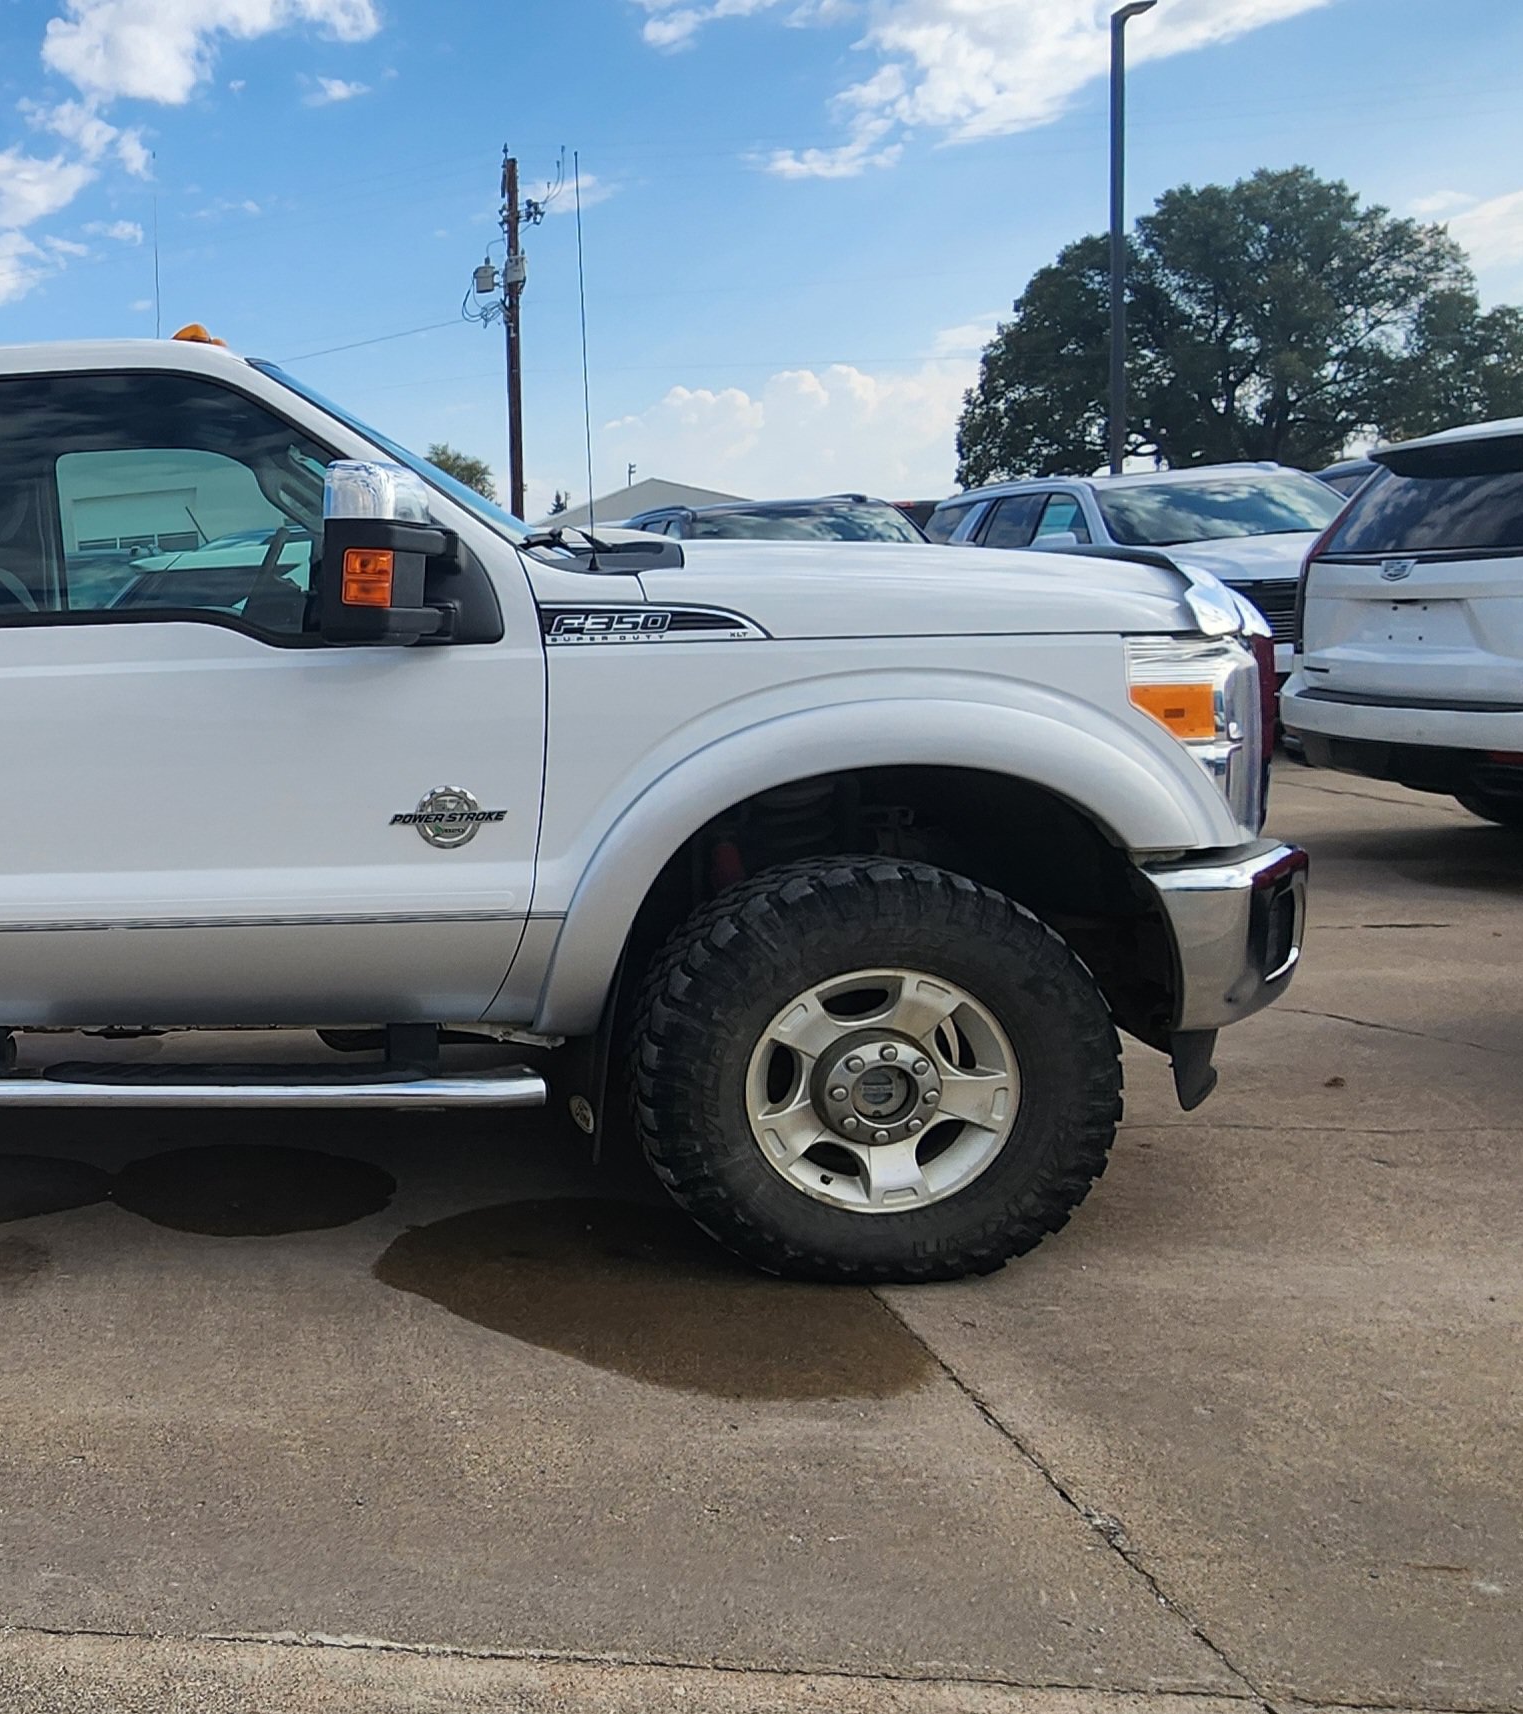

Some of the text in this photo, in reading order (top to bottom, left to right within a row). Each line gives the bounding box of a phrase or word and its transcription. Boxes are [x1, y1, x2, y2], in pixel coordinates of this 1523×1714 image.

[619, 634, 665, 642] DUTY
[389, 810, 508, 826] POWER STROKE
